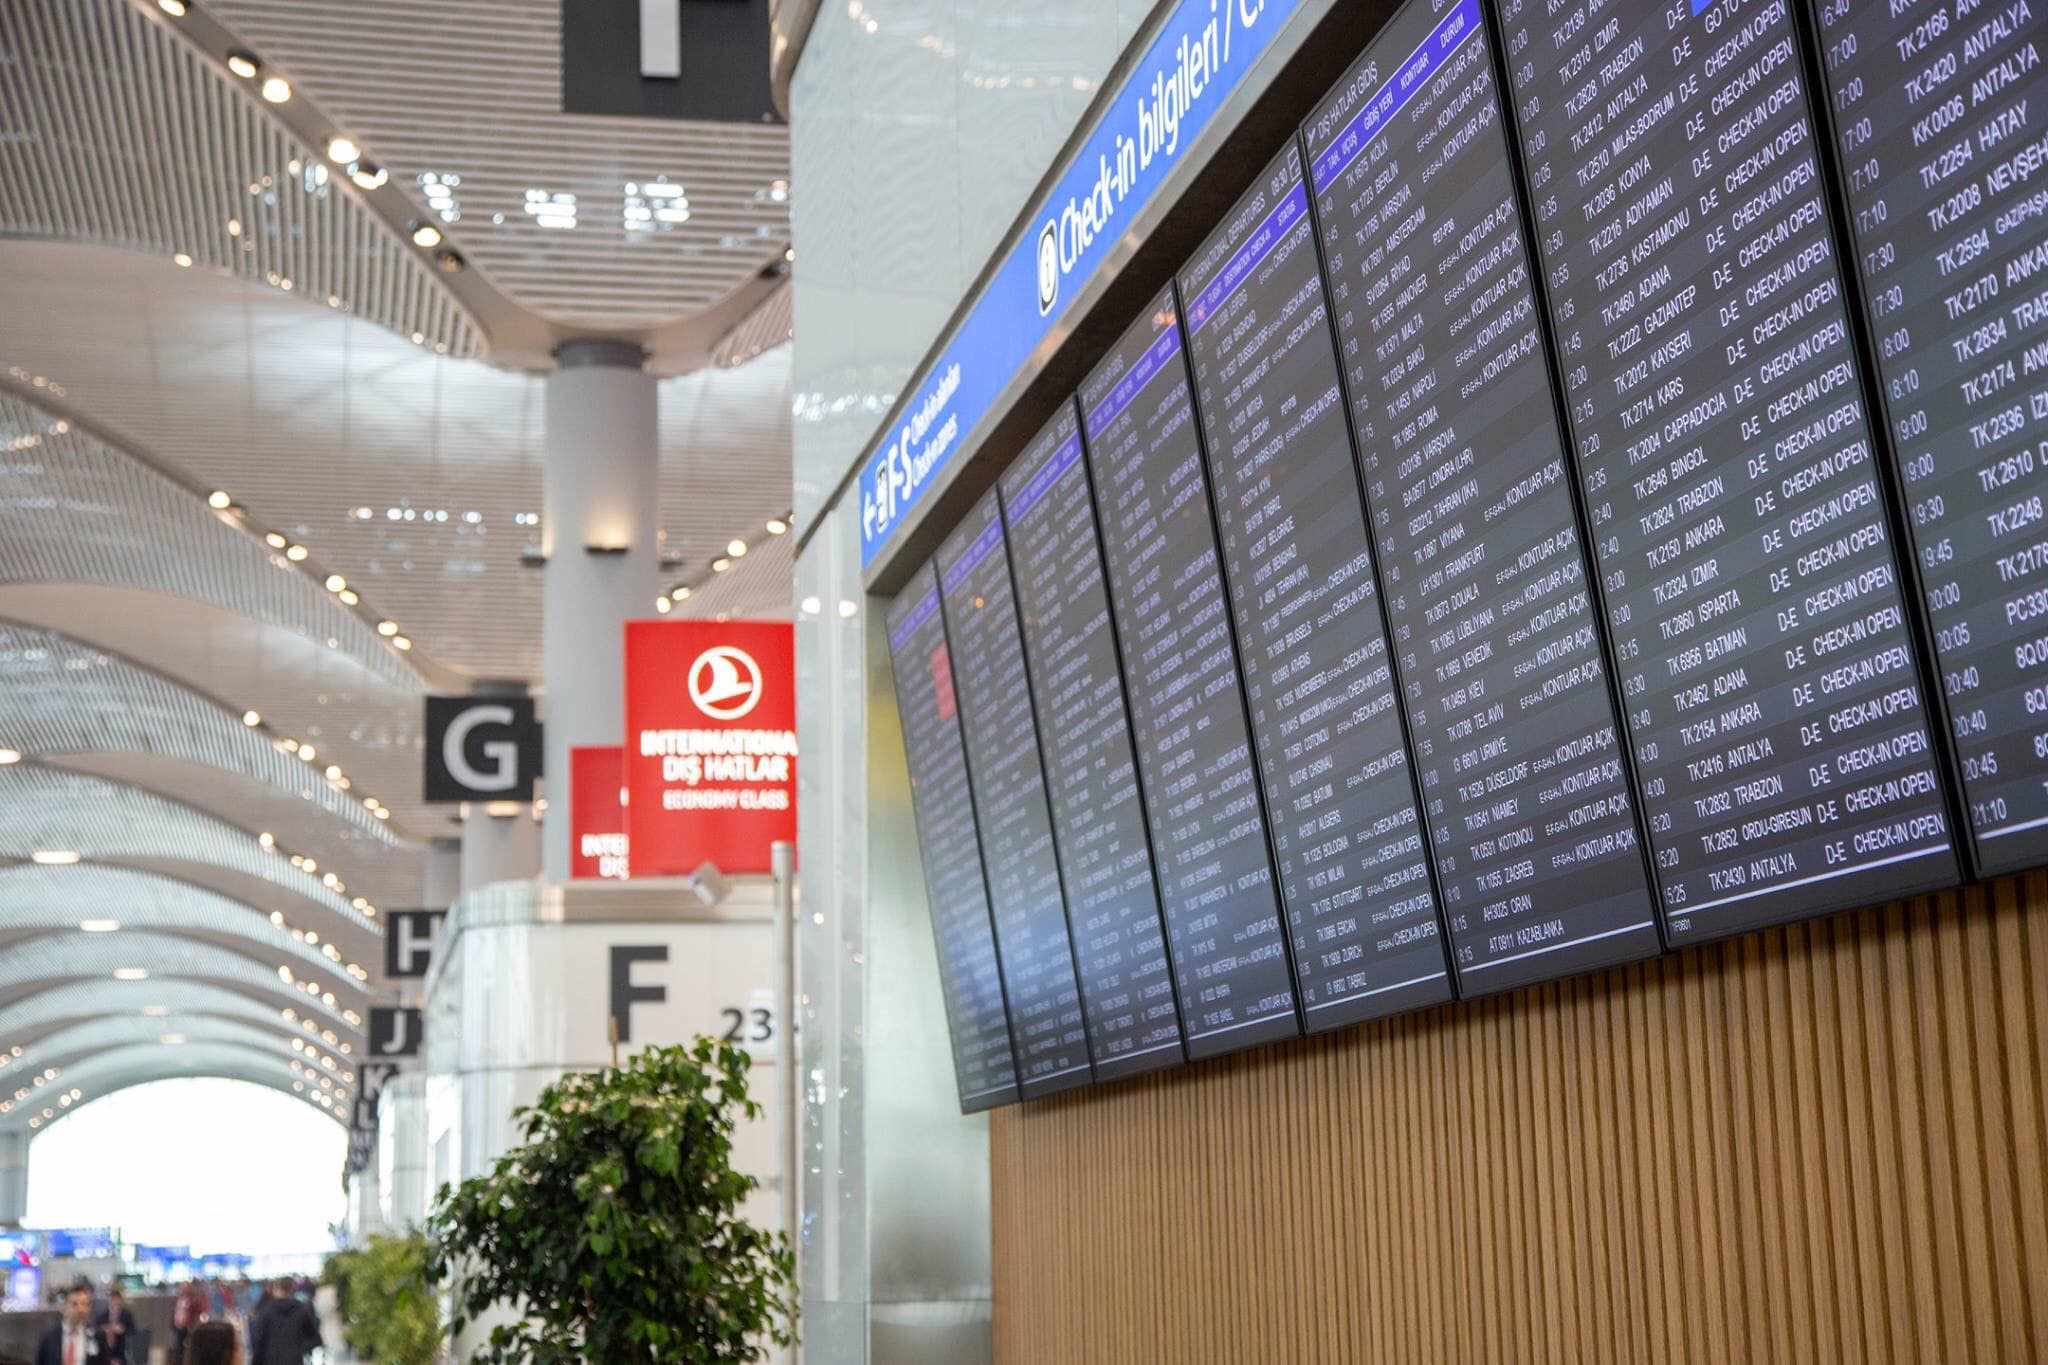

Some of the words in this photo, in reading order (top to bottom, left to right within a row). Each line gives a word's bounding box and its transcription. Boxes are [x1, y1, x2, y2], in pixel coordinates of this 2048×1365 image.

[1593, 17, 1620, 53] IZMIR
[1599, 35, 1643, 87] TRABZON
[1666, 0, 1686, 30] D-E
[1963, 0, 2032, 65] ANTALYA
[1432, 53, 1466, 100] KONTUAR
[1466, 34, 1486, 62] AÇIK
[1611, 91, 1675, 157] MILAS-BODRUM
[1678, 73, 1699, 103] D-E
[1704, 23, 1754, 78] CHECK-IN
[1753, 0, 1786, 36] OPEN
[1971, 42, 2040, 107] ANTALYA
[1329, 83, 1358, 125] HATLAR
[1978, 99, 2027, 152] HATAY
[1059, 133, 1136, 274] Check-in
[1138, 0, 1219, 171] bilgileri
[1626, 176, 1673, 229] ADIYAMAN
[1691, 148, 1712, 178] D-E
[1718, 101, 1768, 154] CHECK-IN
[1767, 75, 1800, 114] OPEN
[1631, 207, 1690, 266] KASTAMONU
[1699, 187, 1719, 216] D-E
[1724, 142, 1775, 193] CHECK-IN
[1775, 117, 1808, 155] OPEN
[1385, 204, 1426, 254] AMSTERDAM
[1459, 213, 1495, 256] KONTUAR
[1495, 195, 1515, 226] AÇIK
[1644, 284, 1696, 334] GAZIANTEP
[1712, 261, 1733, 290] D-E
[1738, 219, 1790, 268] CHECK-IN
[1789, 196, 1822, 233] OPEN
[1656, 376, 1684, 407] KARS
[1726, 337, 1747, 365] D-E
[1752, 298, 1804, 345] CHECK-IN
[1803, 277, 1837, 312] OPEN
[1417, 405, 1439, 431] ROMA
[1482, 343, 1519, 382] KONTUAR
[1519, 327, 1539, 356] AÇIK
[1676, 475, 1724, 515] TRABZON
[1747, 452, 1769, 479] D-E
[1774, 418, 1827, 461] CHECK-IN
[1826, 399, 1861, 433] OPEN
[1685, 515, 1725, 551] ANKARA
[1754, 490, 1776, 516] D-E
[1781, 457, 1834, 499] CHECK-IN
[1834, 439, 1869, 472] OPEN
[1444, 543, 1485, 581] FRANKFURT
[1704, 627, 1747, 661] BATMAN
[1777, 606, 1799, 632] D-E
[1804, 578, 1858, 617] CHECK-IN
[1858, 562, 1893, 594] OPEN
[1720, 701, 1762, 733] ANKARA
[1792, 682, 1815, 707] D-E
[1820, 658, 1875, 694] CHECK-IN
[1874, 644, 1910, 674] OPEN
[442, 705, 519, 792] G
[640, 729, 799, 757] INTERNATIONA
[662, 755, 702, 786] DIŞ
[704, 755, 789, 782] HATLAR
[1555, 734, 1594, 764] KONTUAR
[1594, 726, 1616, 750] AÇIK
[662, 789, 738, 810] ECONOMY
[739, 789, 789, 810] CLASS
[1497, 825, 1534, 852] KOTONOU
[1567, 799, 1607, 828] KONTUAR
[1608, 791, 1629, 815] AÇIK
[1750, 852, 1797, 881] ANTALYA
[1824, 840, 1847, 865] D-E
[1853, 822, 1909, 854] CHECK-IN
[1908, 812, 1946, 839] OPEN
[1509, 893, 1532, 914] ORAN
[1515, 918, 1565, 946] KAZABLANKA
[398, 915, 442, 972] H
[610, 945, 668, 1042] F
[382, 1010, 407, 1053] J
